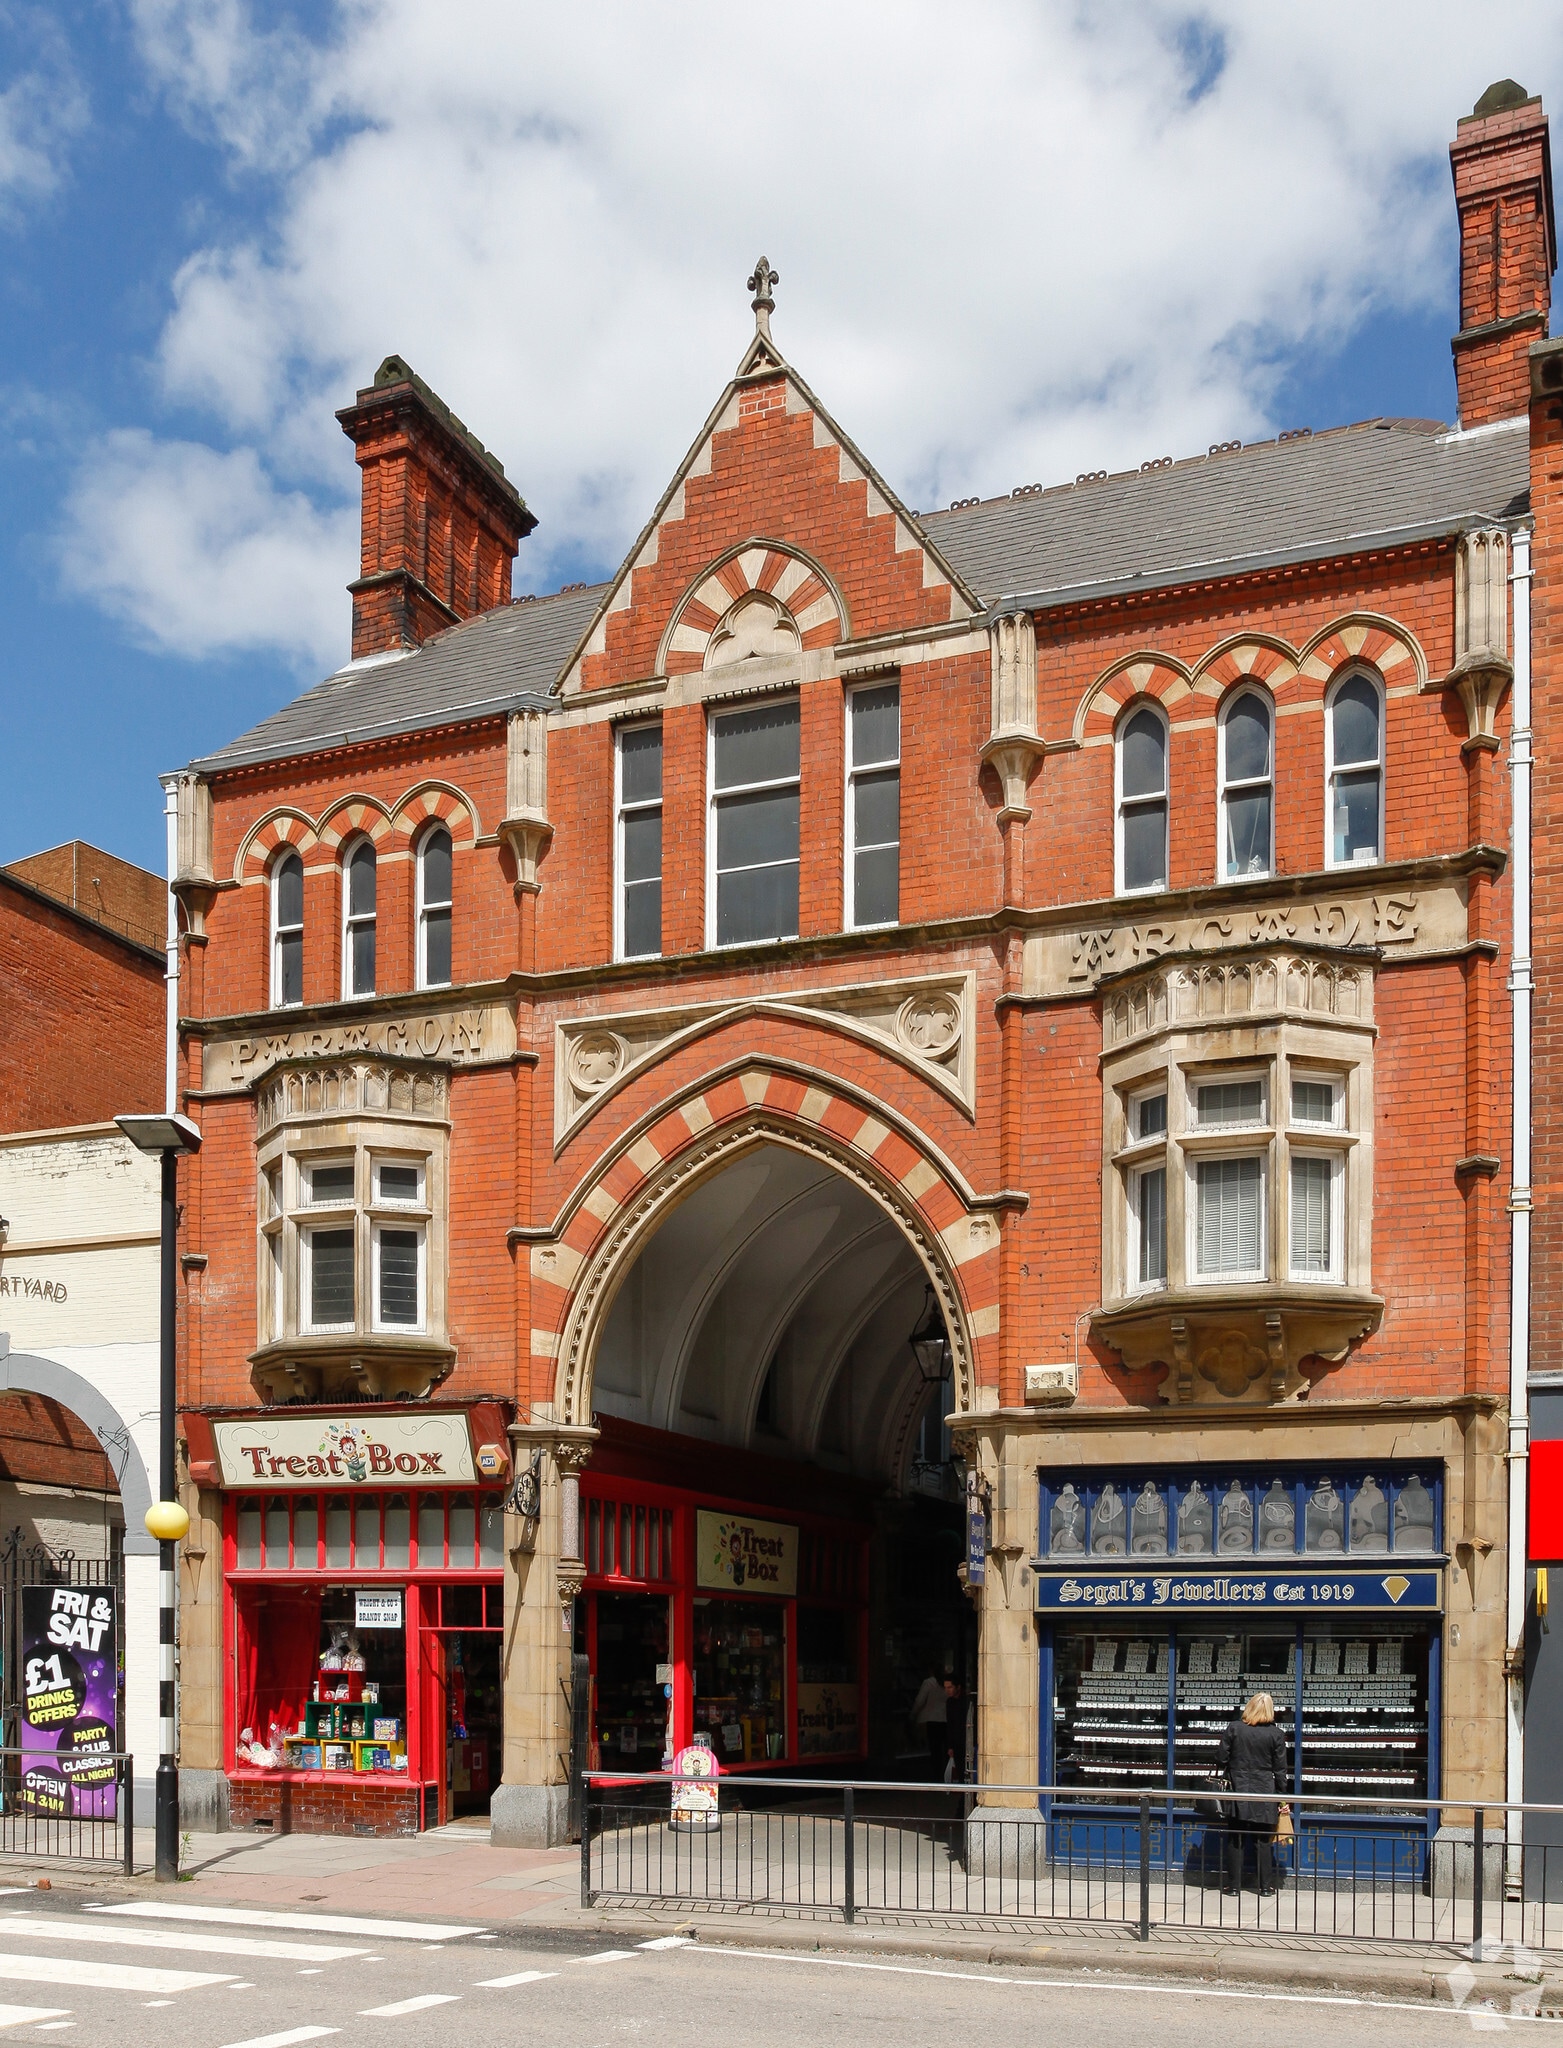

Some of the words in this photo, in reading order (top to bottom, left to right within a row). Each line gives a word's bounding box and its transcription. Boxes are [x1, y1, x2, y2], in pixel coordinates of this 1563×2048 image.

[1068, 891, 1420, 983] ARCADE
[230, 1009, 484, 1080] PARAGON
[0, 1276, 68, 1303] RTYARD
[241, 1447, 344, 1478] Treat
[364, 1443, 446, 1476] Box
[740, 1526, 784, 1558] Treat
[747, 1554, 779, 1582] Box
[51, 1589, 90, 1617] FRI
[90, 1597, 112, 1621] &
[1059, 1579, 1146, 1606] Segal's
[1152, 1578, 1267, 1604] Jewellers
[1273, 1584, 1306, 1601] Est
[1311, 1584, 1355, 1601] 1919
[359, 1612, 381, 1622] BRANDY
[383, 1612, 398, 1622] SNAP
[47, 1612, 109, 1652] SAT
[25, 1653, 72, 1695] £1
[27, 1689, 75, 1710] DRINKS
[29, 1704, 78, 1725] OFFERS
[73, 1726, 107, 1743] PARTY
[82, 1740, 111, 1753] CLUB
[62, 1757, 114, 1773] CLASSICS
[71, 1772, 88, 1783] ALL
[87, 1767, 115, 1781] NIGHT
[26, 1771, 67, 1797] OPEN
[38, 1794, 65, 1812] 3AM
